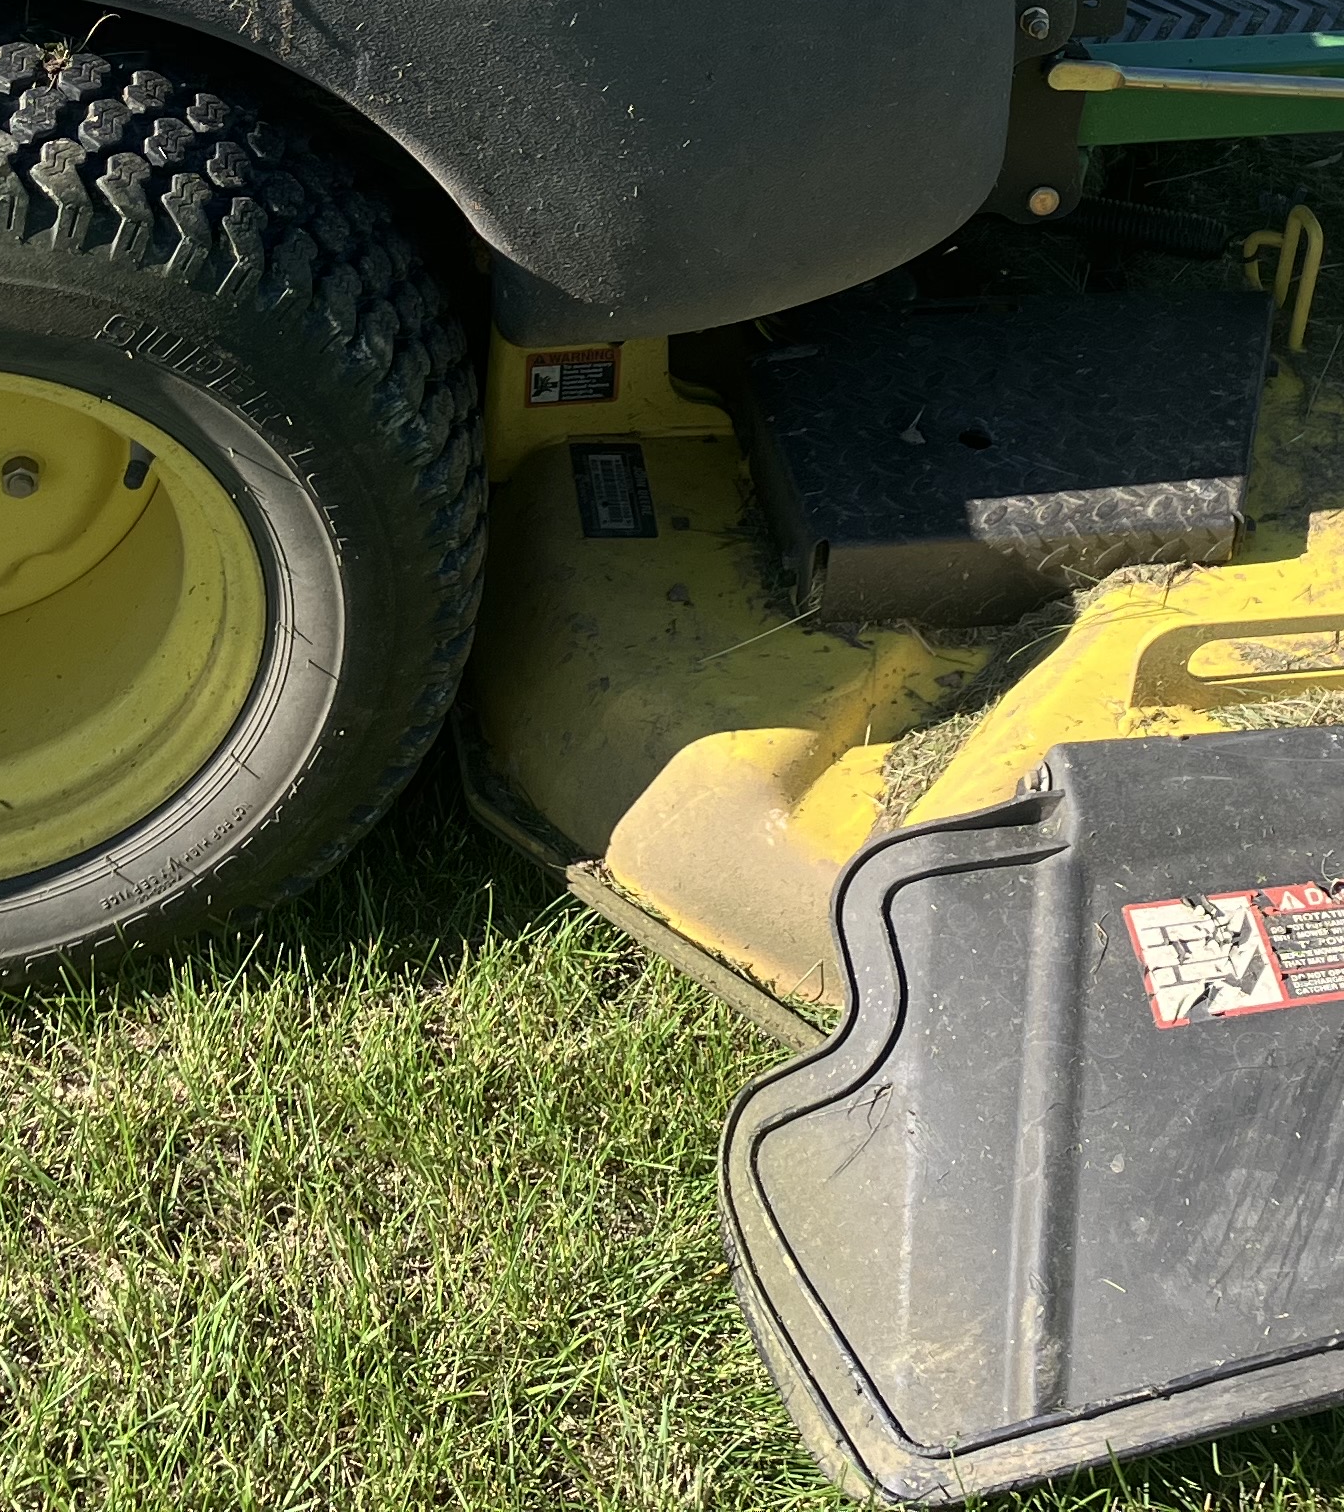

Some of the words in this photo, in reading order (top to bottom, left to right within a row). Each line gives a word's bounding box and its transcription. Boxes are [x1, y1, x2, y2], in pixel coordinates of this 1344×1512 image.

[551, 350, 613, 363] WARNING
[1283, 959, 1306, 967] THAT
[1295, 984, 1337, 994] CATCHER
